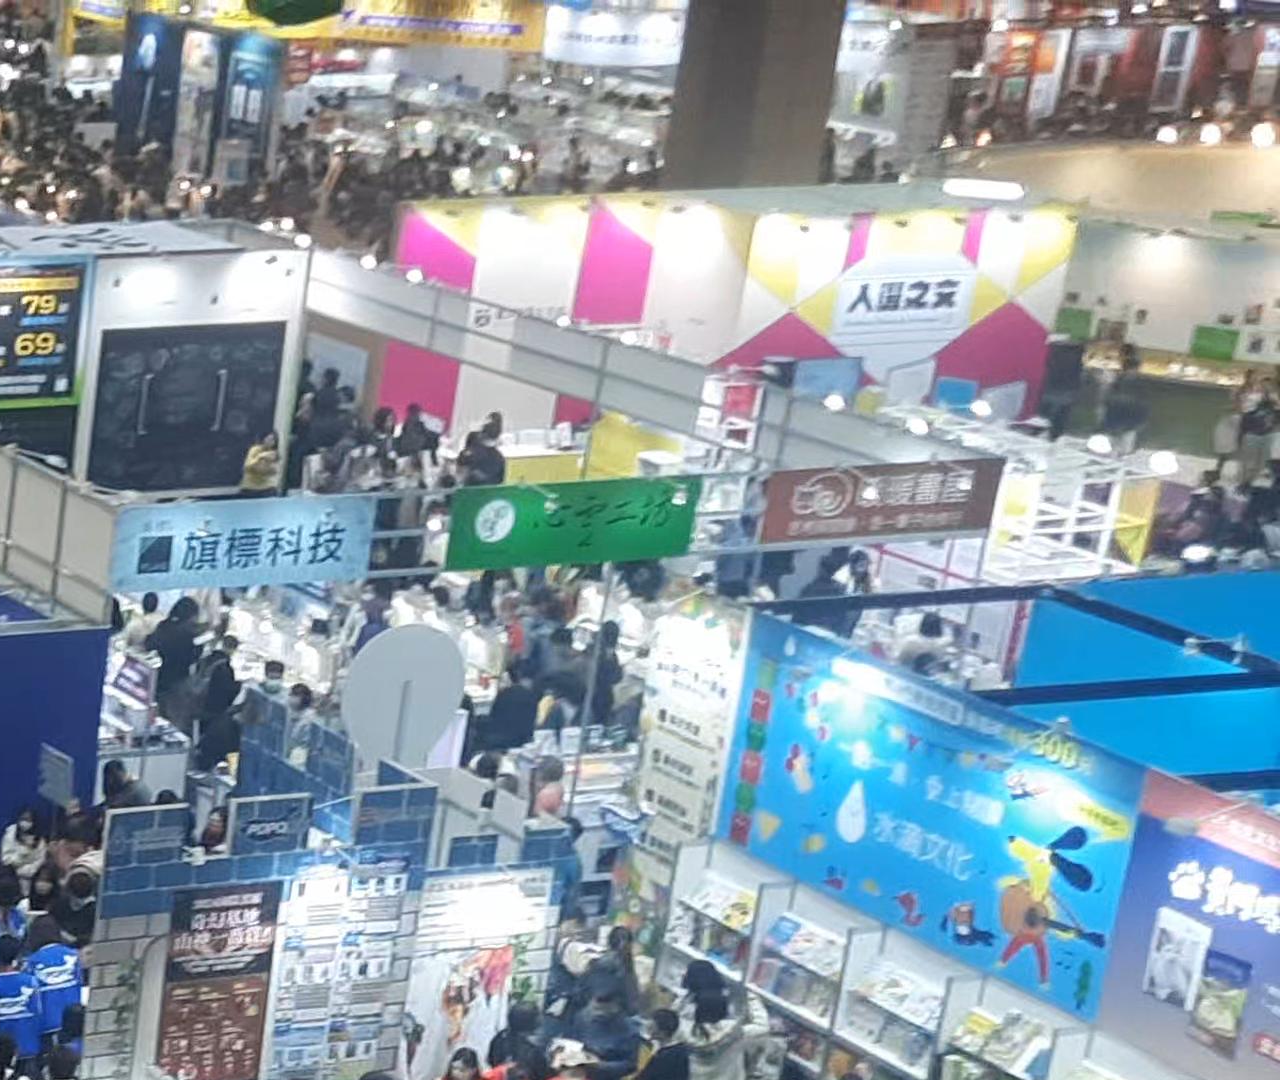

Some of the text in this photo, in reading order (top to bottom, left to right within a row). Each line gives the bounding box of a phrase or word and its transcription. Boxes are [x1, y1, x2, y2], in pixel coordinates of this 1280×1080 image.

[181, 525, 346, 570] 旗標科技
[246, 822, 288, 836] POPO
